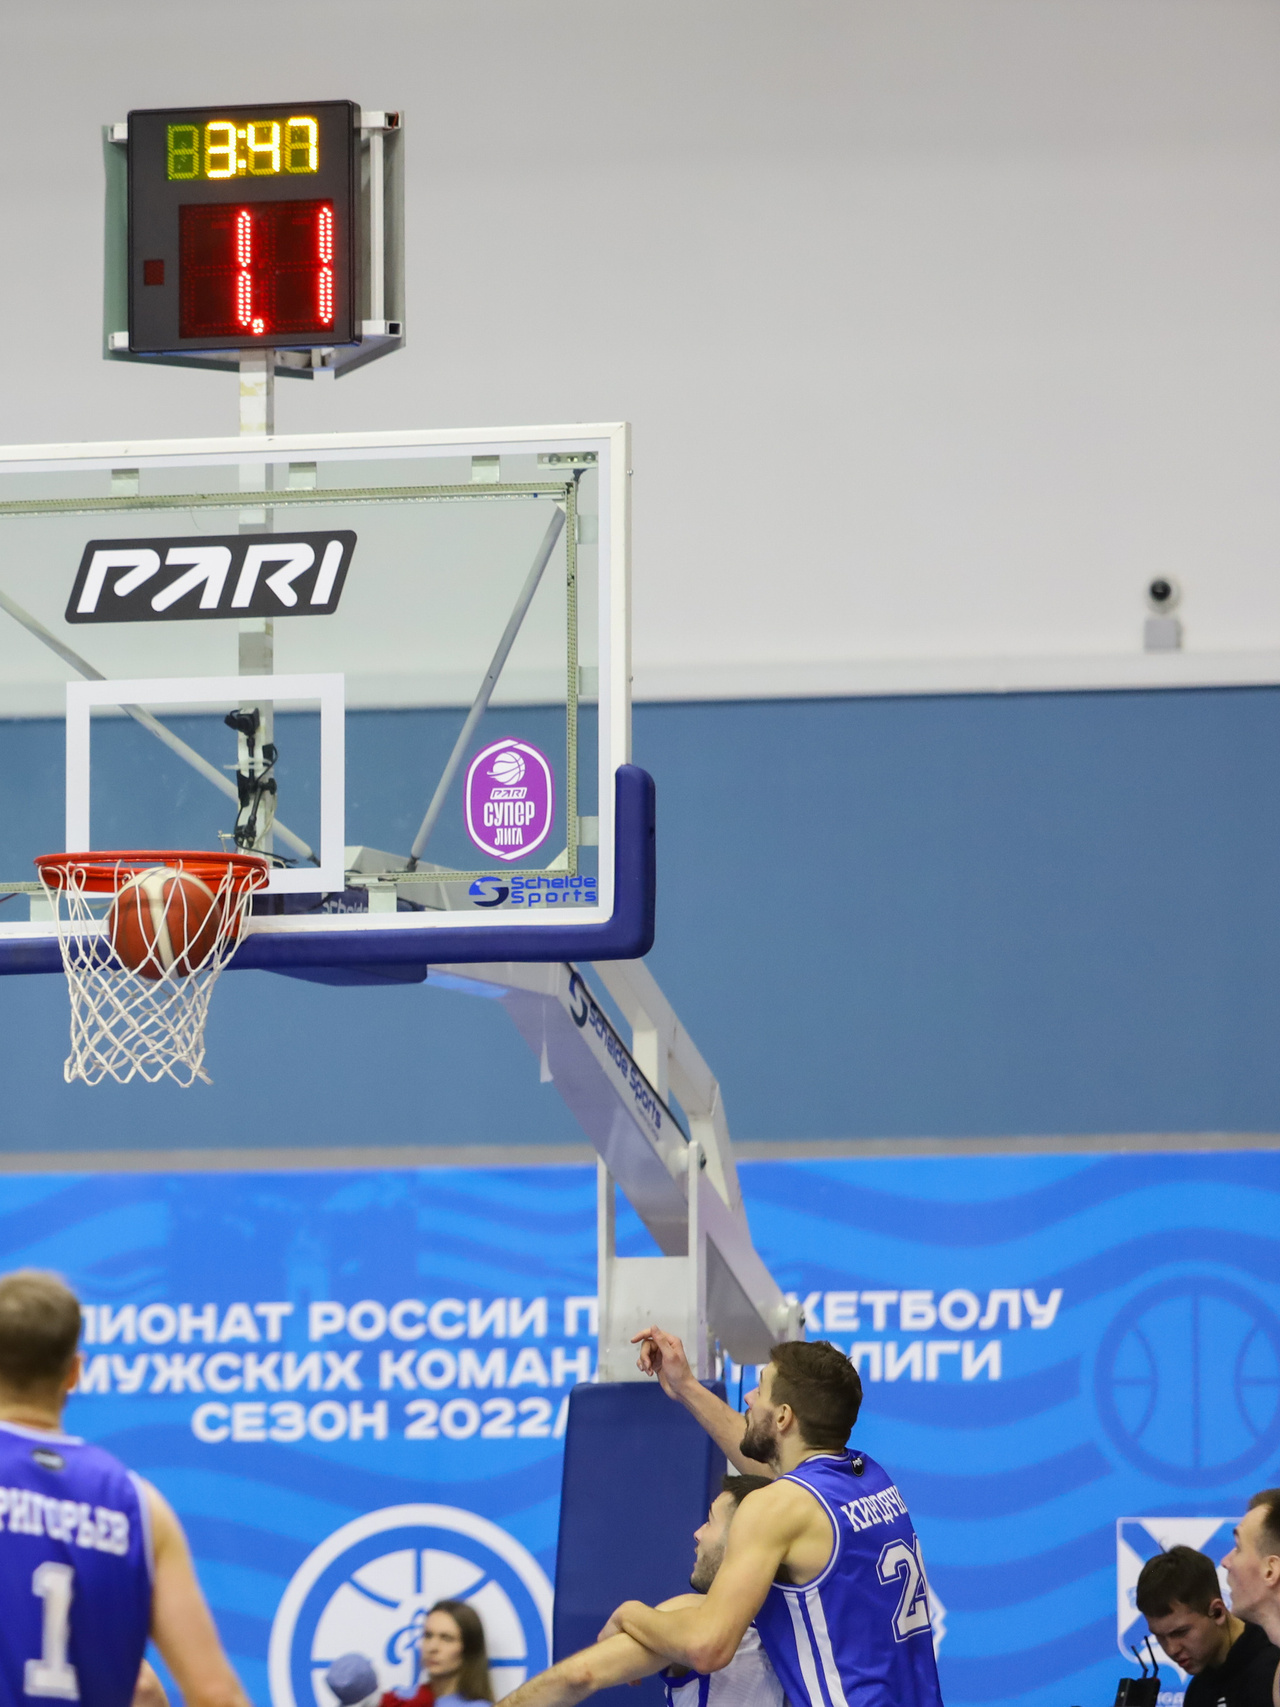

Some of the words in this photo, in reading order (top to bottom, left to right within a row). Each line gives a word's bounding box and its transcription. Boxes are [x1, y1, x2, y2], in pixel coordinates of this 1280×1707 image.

[204, 116, 319, 179] 3:47
[76, 540, 344, 613] PARI
[491, 788, 526, 799] PARI
[494, 827, 524, 846] ЛИГА
[510, 889, 597, 907] Sports
[308, 1298, 548, 1341] РОССИИ
[378, 1346, 599, 1389] КОМАН
[191, 1401, 389, 1443] СЕЗОН
[404, 1394, 570, 1441] 2022/
[24, 1561, 79, 1700] 1
